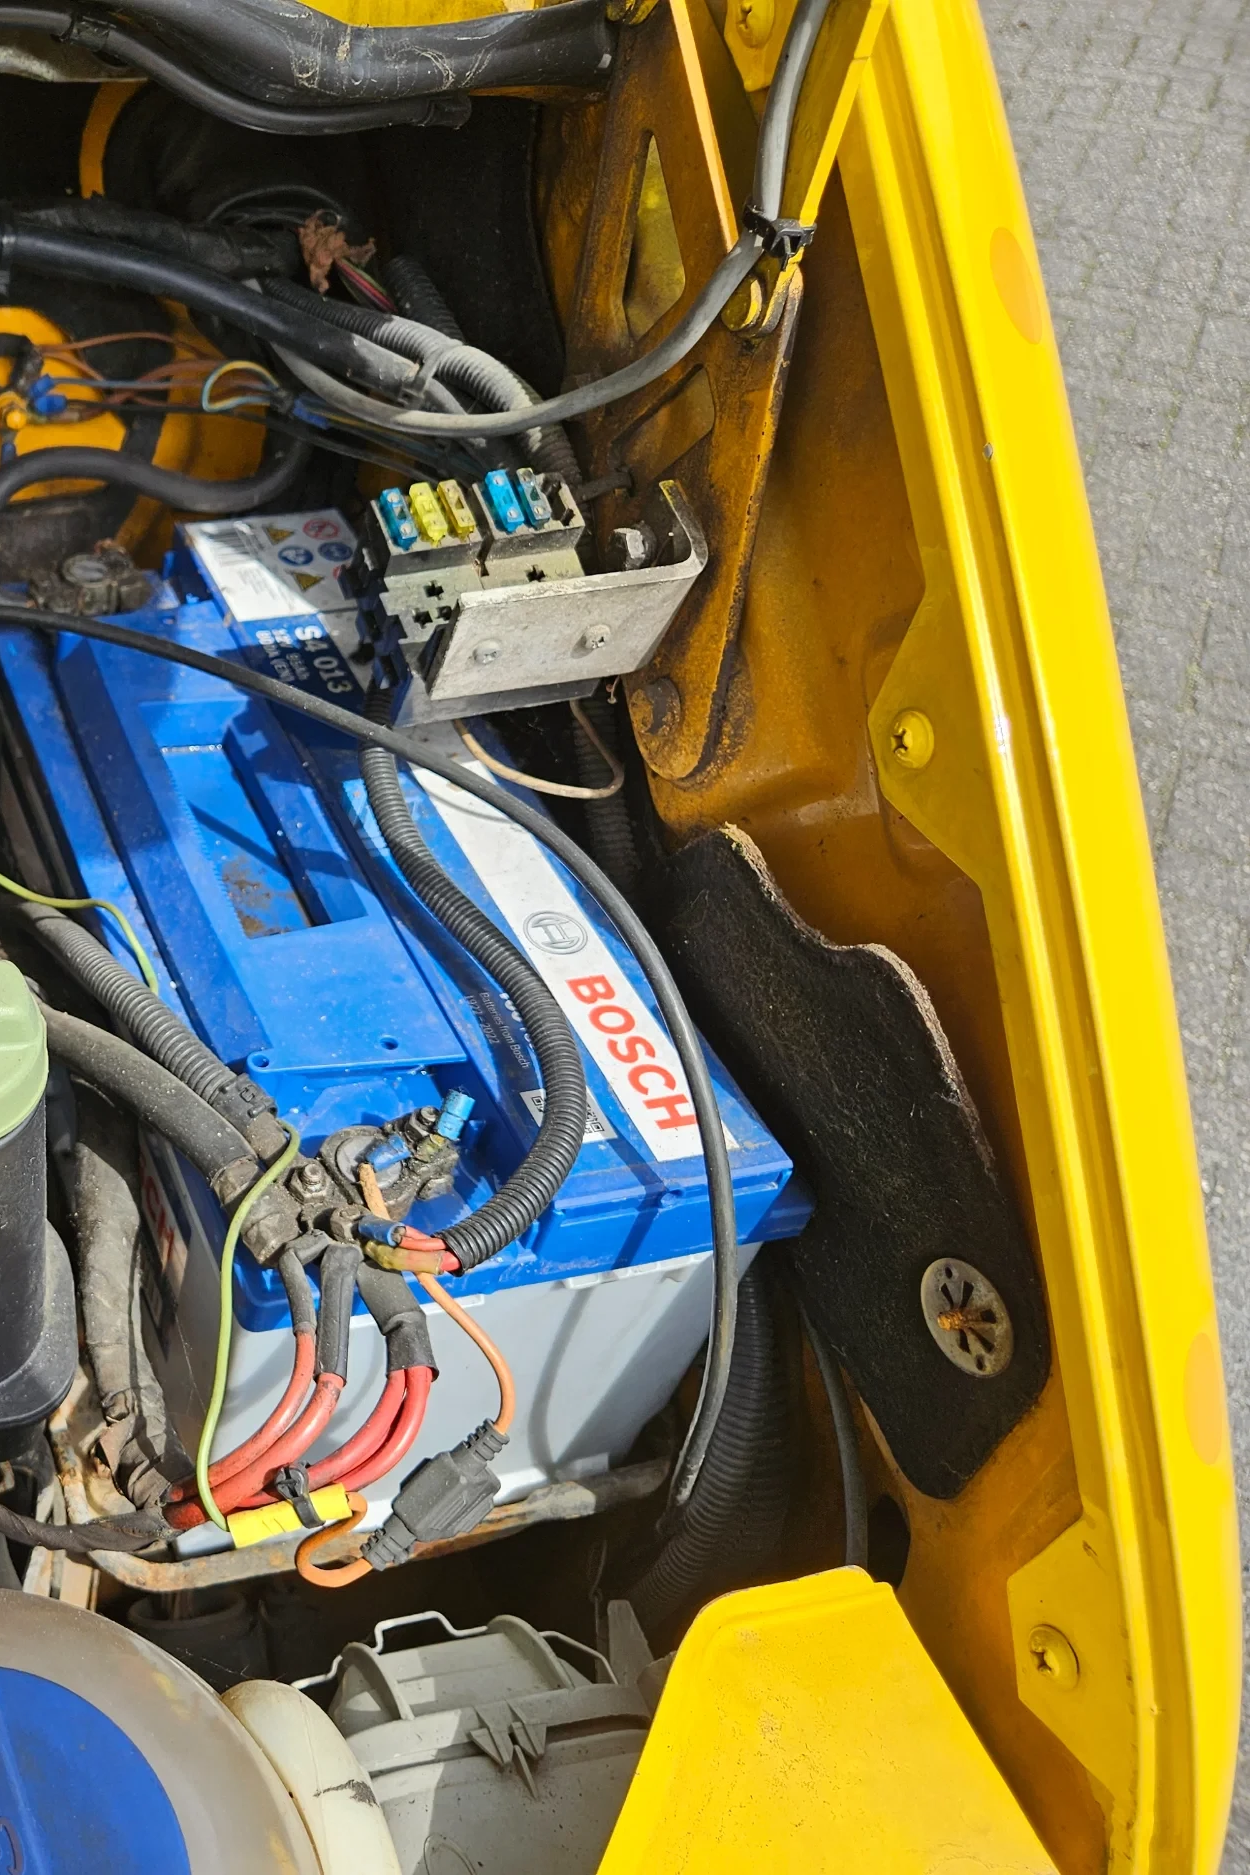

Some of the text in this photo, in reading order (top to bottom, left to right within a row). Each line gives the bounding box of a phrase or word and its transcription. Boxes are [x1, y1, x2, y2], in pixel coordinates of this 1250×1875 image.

[294, 625, 353, 693] S4 013
[464, 995, 484, 1015] 1922
[480, 1023, 500, 1044] 2022
[479, 991, 503, 1026] Batteries
[499, 1025, 514, 1044] from
[510, 1044, 530, 1069] Bosch
[565, 974, 697, 1130] BOSCH
